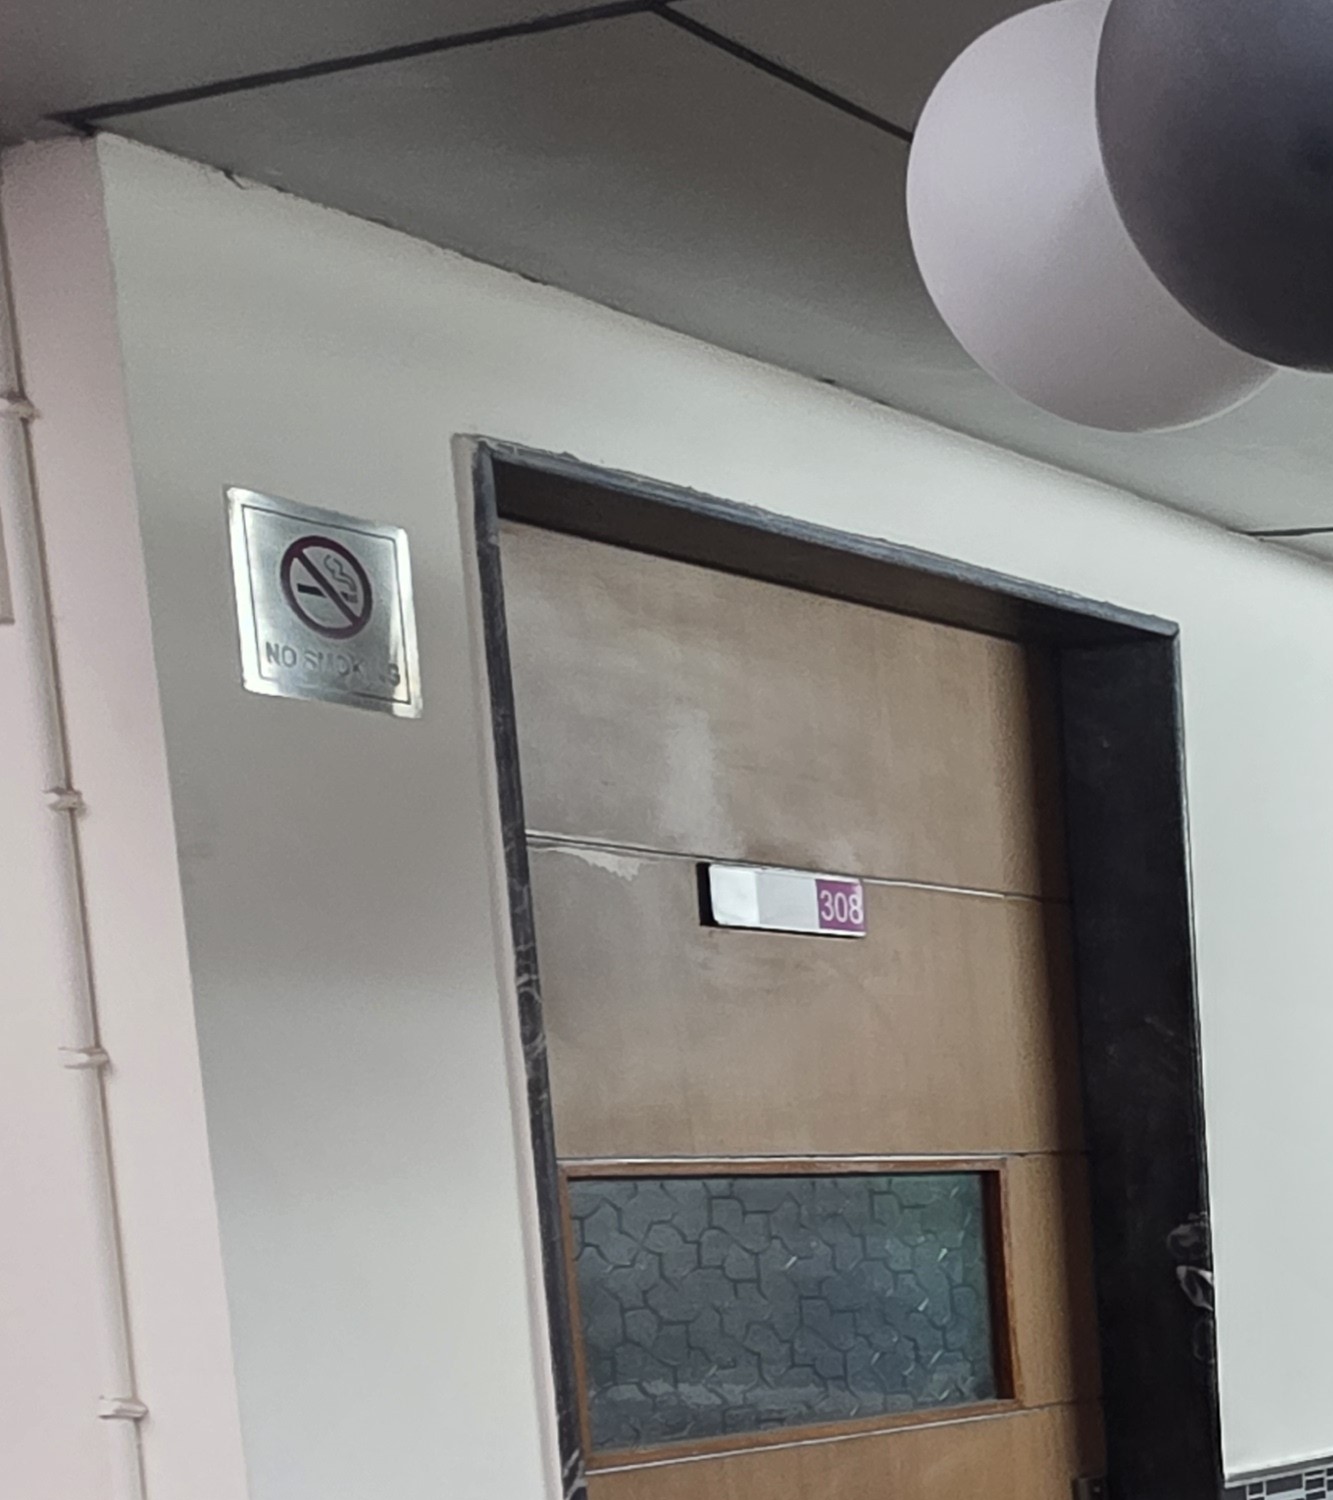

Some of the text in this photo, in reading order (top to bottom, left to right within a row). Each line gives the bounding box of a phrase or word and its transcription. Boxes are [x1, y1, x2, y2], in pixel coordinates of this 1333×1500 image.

[265, 641, 401, 687] NO SMOKG
[820, 890, 864, 924] 308
